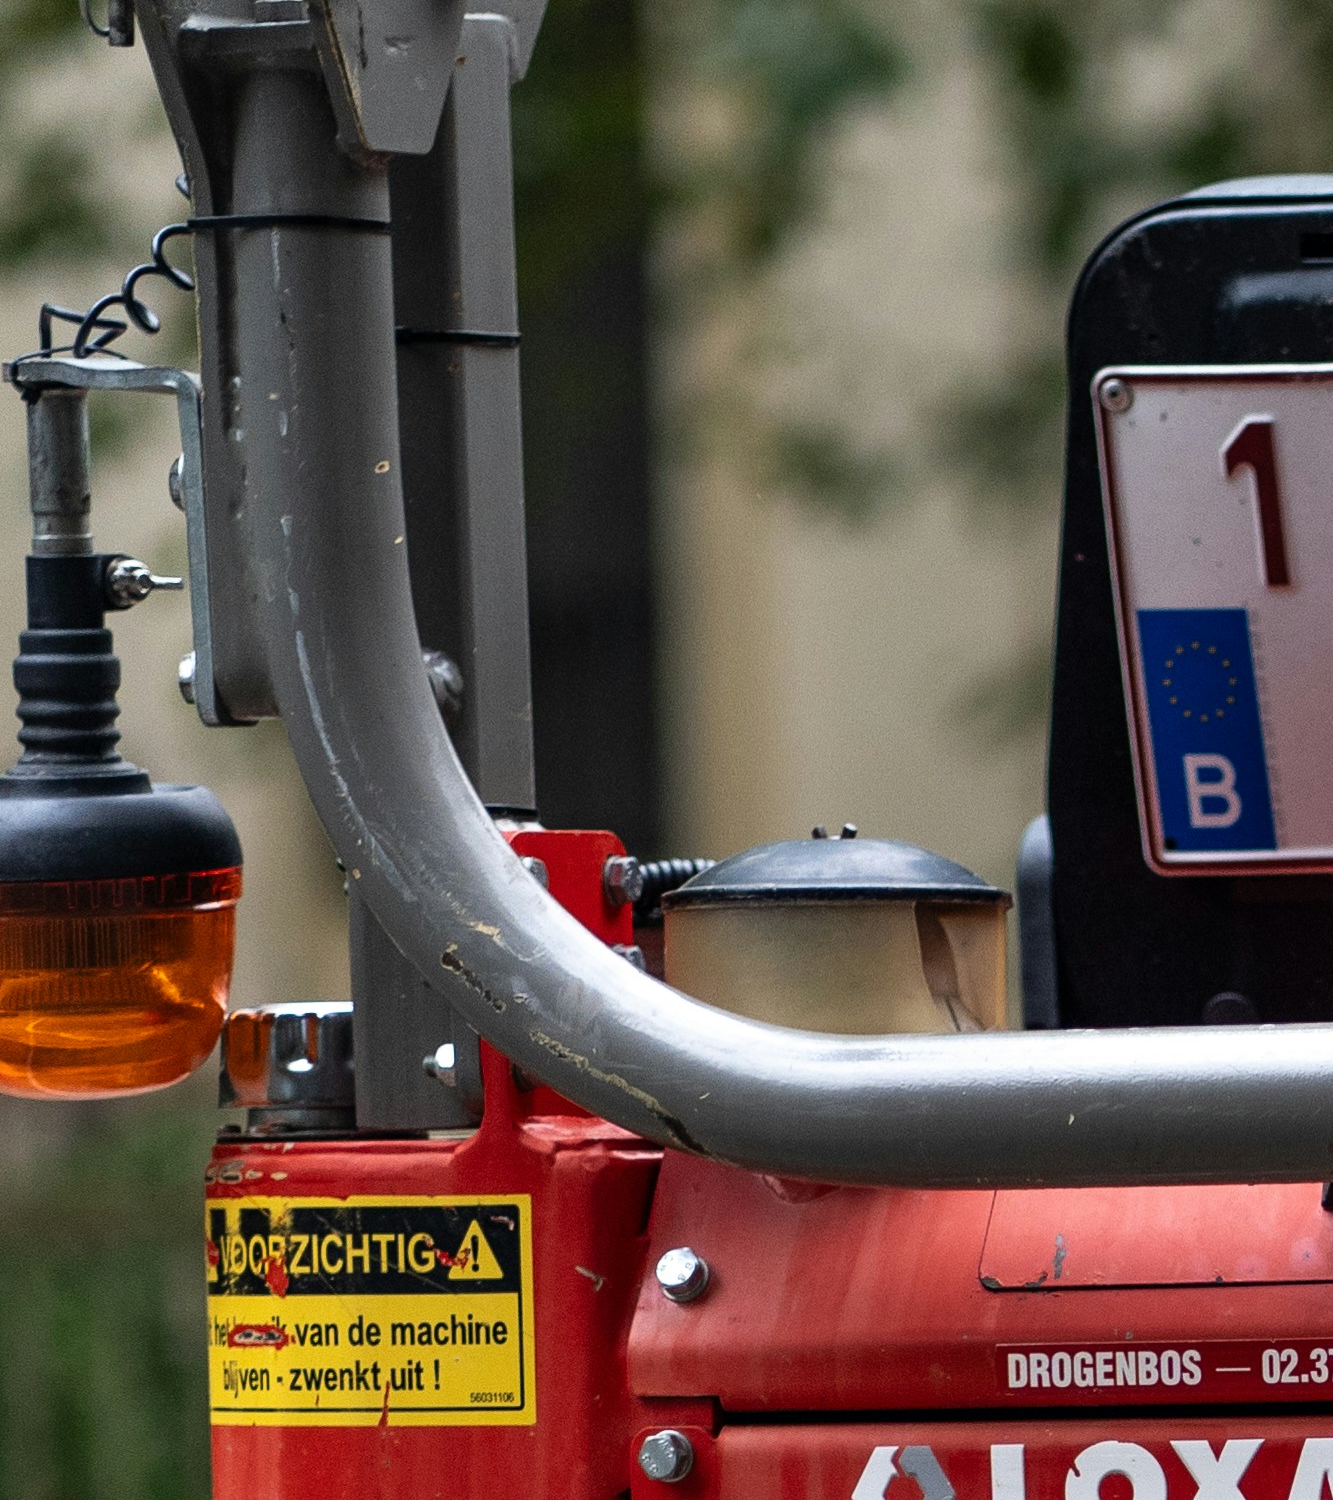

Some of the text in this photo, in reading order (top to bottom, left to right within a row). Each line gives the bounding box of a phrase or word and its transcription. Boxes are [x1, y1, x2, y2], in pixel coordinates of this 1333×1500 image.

[1182, 752, 1243, 829] B
[294, 1322, 339, 1347] van
[347, 1314, 382, 1347] de
[390, 1313, 508, 1346] machine
[289, 1358, 382, 1392] zwenkt
[389, 1358, 425, 1391] uit
[1007, 1349, 1202, 1388] DROGENBOS
